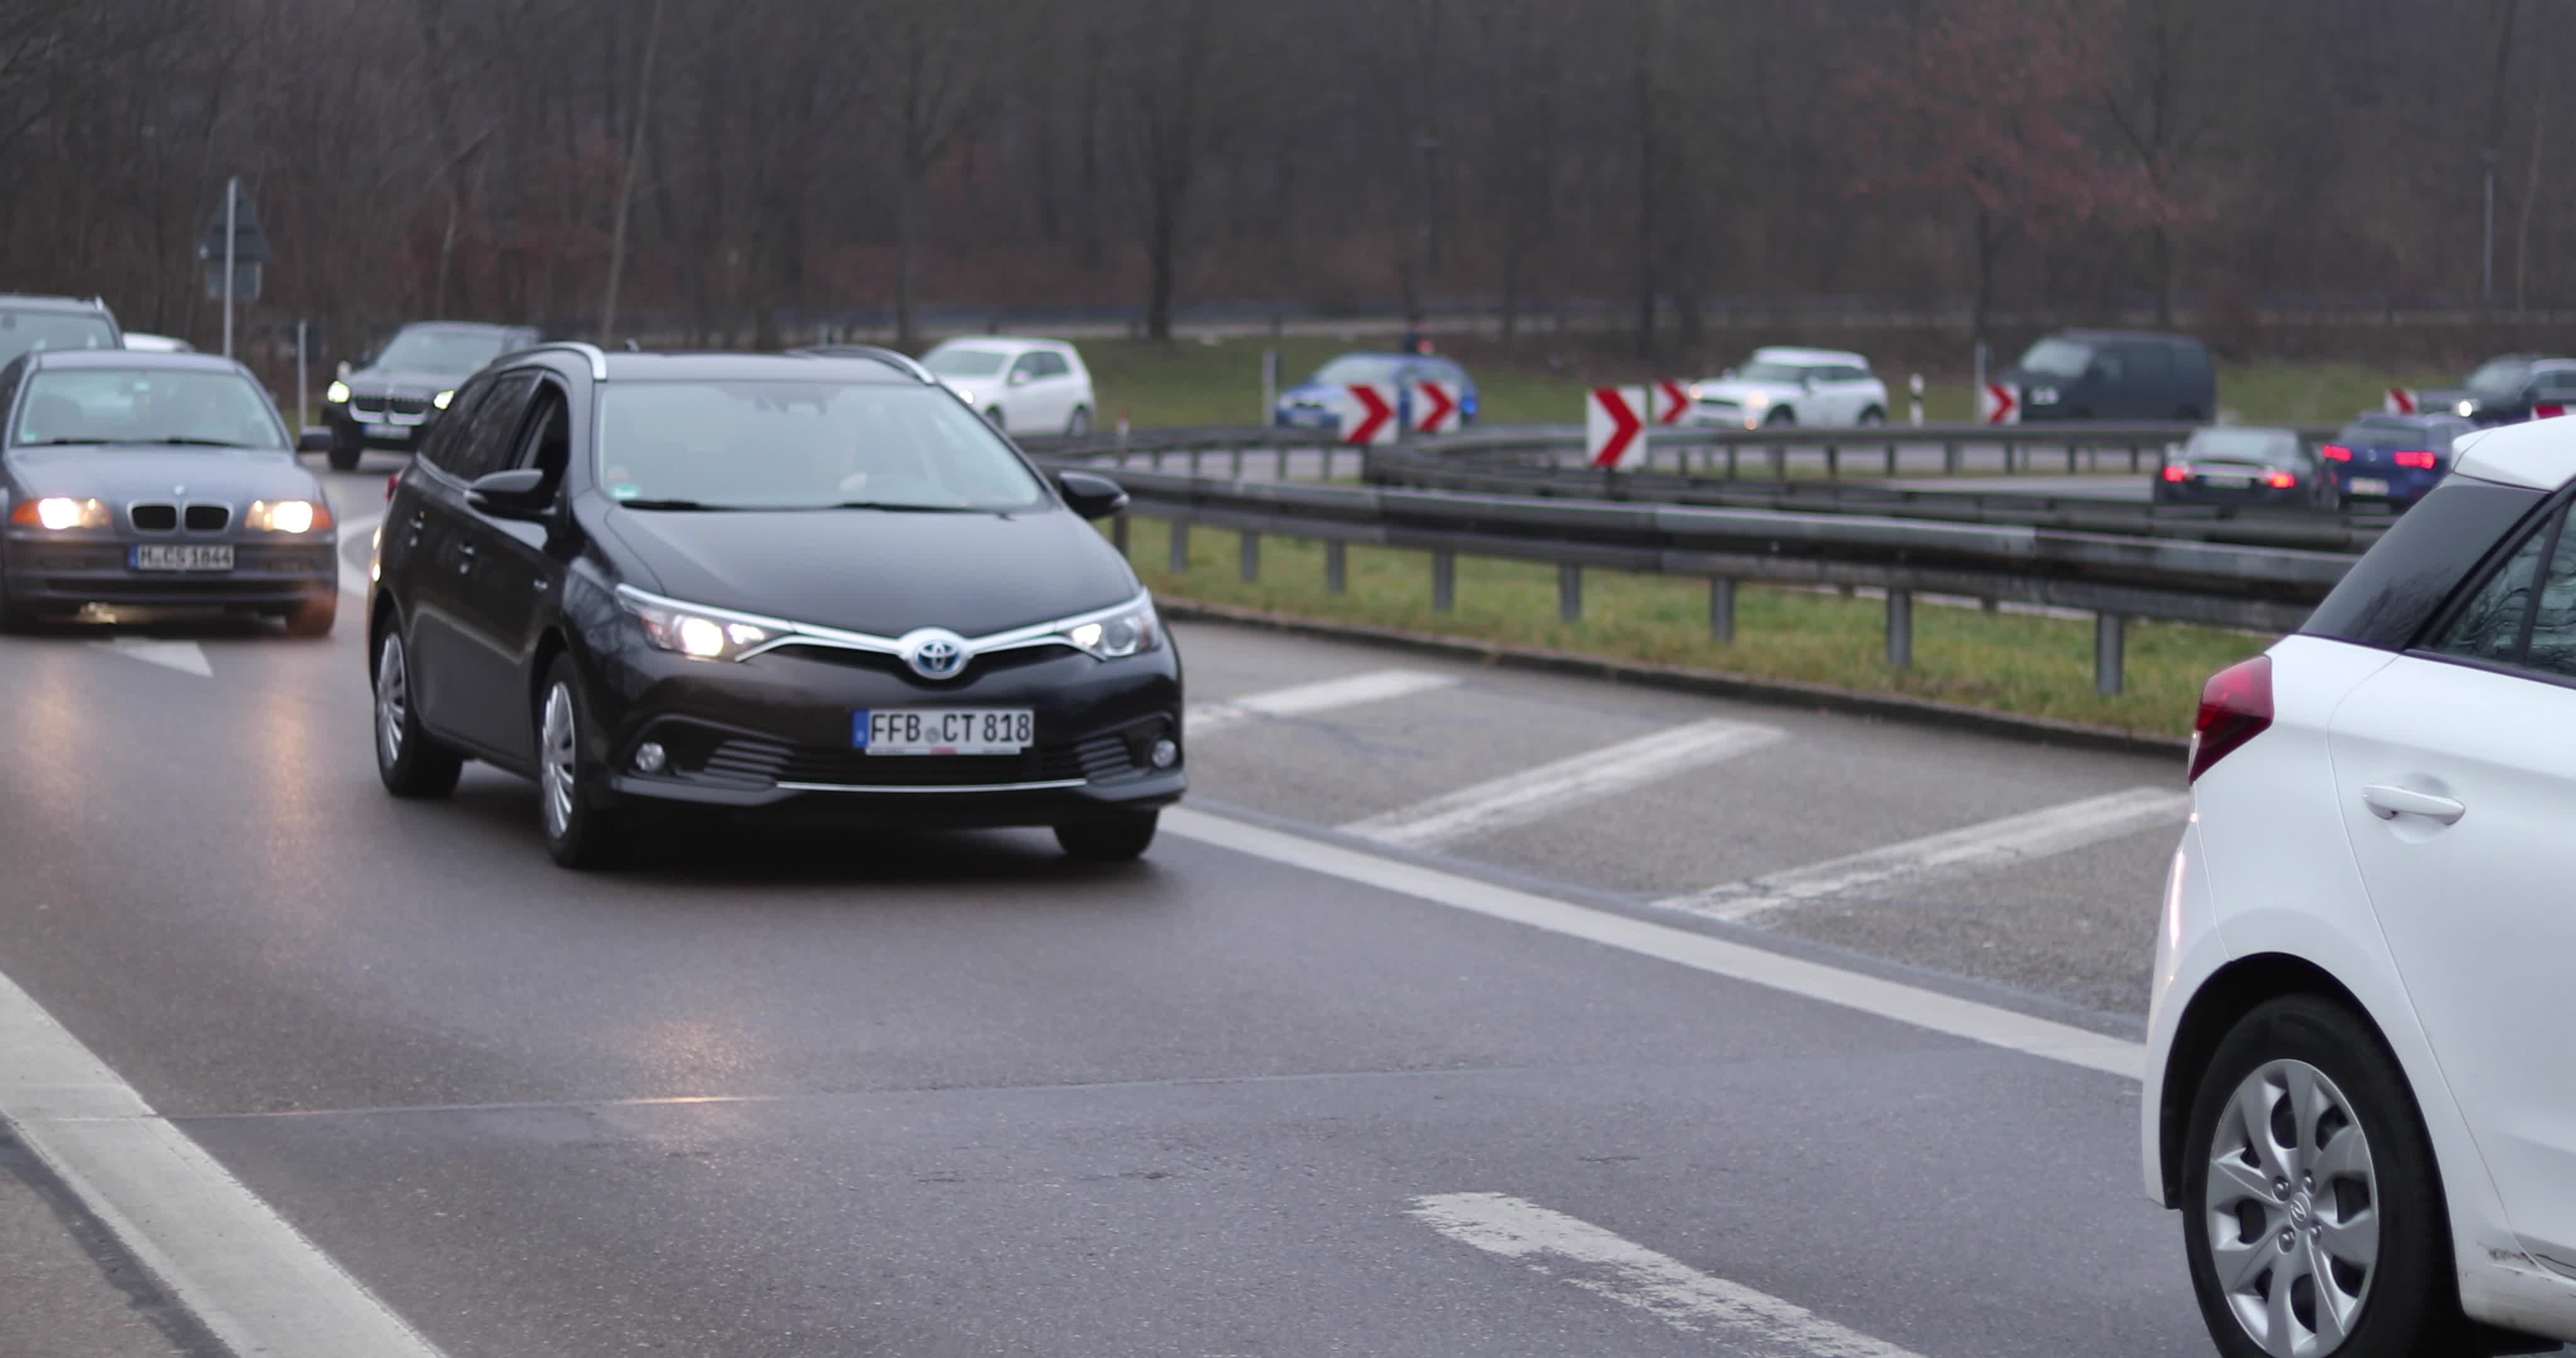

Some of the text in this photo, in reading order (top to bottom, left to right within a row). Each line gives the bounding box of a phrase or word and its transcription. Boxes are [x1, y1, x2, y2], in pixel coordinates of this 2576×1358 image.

[871, 714, 1031, 742] FFB CT 818
